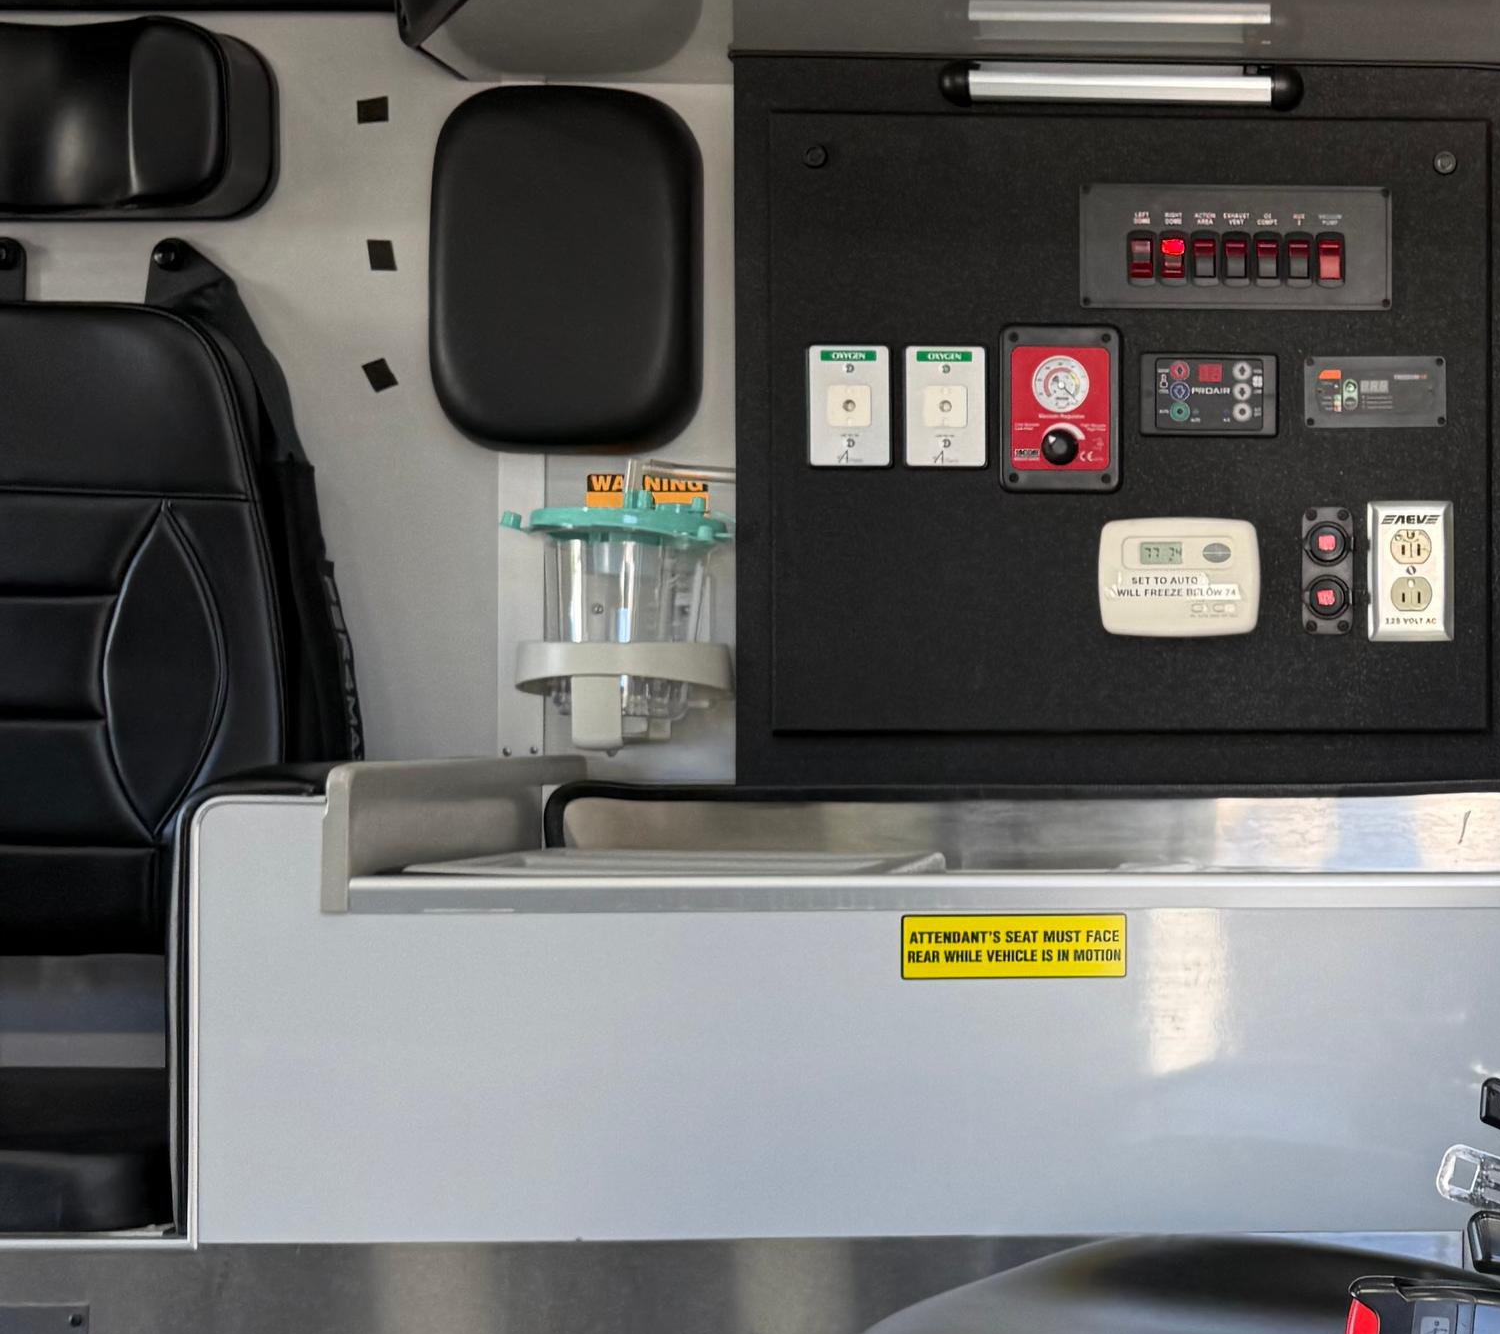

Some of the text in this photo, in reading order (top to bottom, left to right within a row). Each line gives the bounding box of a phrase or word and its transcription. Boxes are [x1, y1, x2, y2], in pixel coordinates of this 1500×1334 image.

[831, 352, 866, 360] OXYGEN
[927, 353, 962, 361] OXYGEN
[590, 474, 704, 492] WANING
[1131, 576, 1198, 585] SET TO AUTO
[1117, 588, 1141, 597] WILL
[1144, 588, 1183, 597] FREEZE
[1403, 617, 1423, 625] VOLT
[1425, 617, 1437, 625] AC
[909, 929, 1120, 944] ATTENDANT'S SEAT MUST FACE
[907, 948, 1122, 964] REAR WHILE VEHICLE IS IN MOTION
